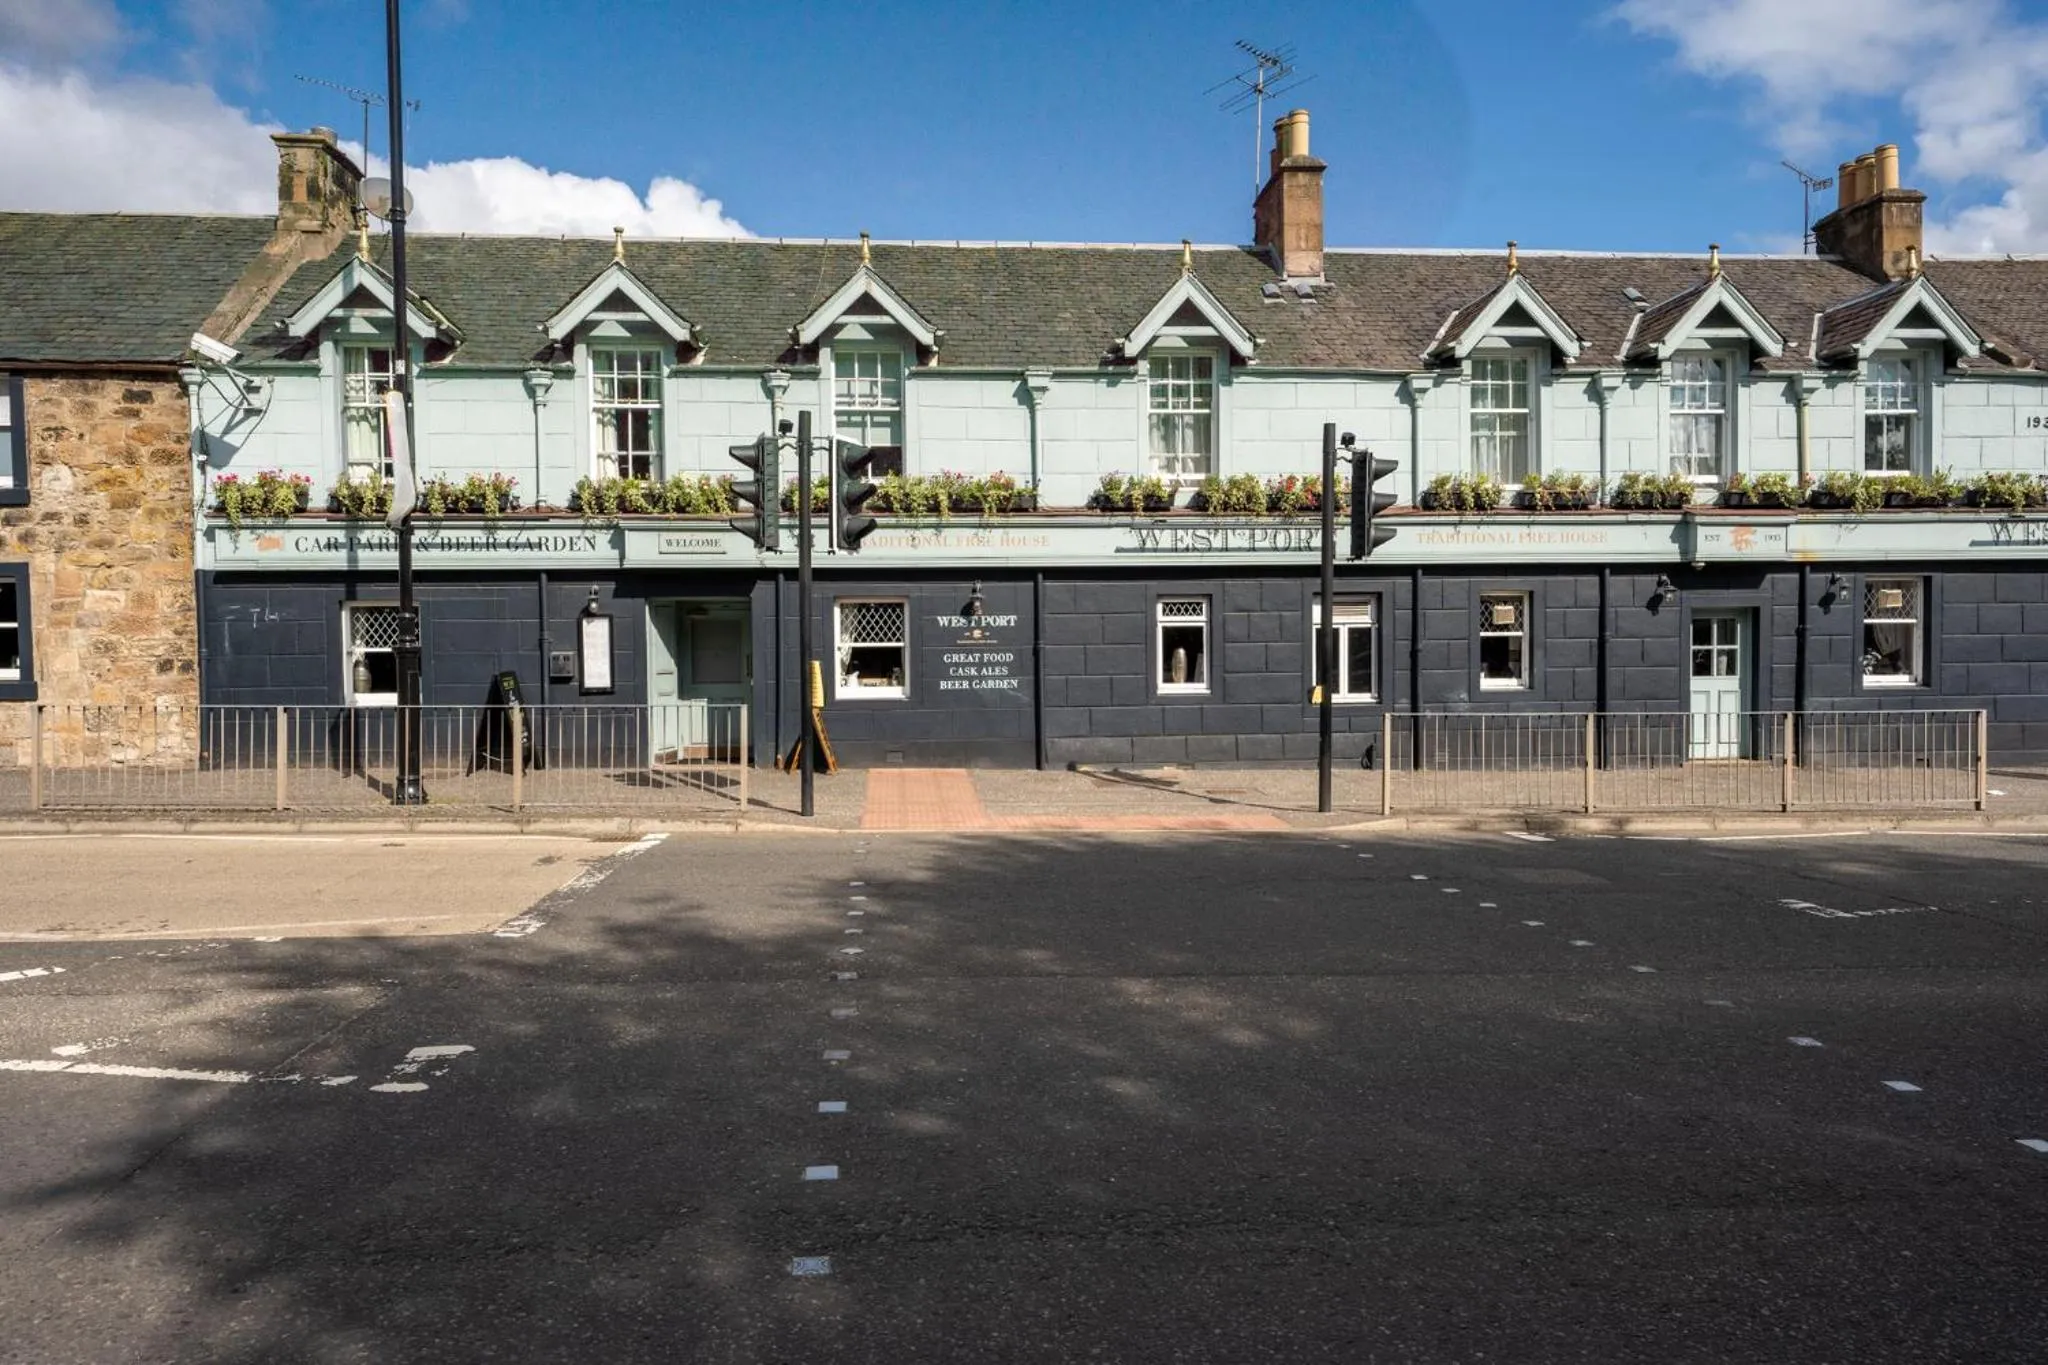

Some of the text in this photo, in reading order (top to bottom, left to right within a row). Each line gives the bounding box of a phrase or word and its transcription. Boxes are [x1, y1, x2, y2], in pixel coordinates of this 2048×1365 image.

[295, 537, 339, 552] CAR
[416, 536, 429, 552] &
[440, 536, 498, 551] BEER
[506, 536, 597, 551] GARDEN
[666, 539, 721, 547] WELCOME
[861, 535, 1050, 548] ADITIONAL FREE HOUSE
[1131, 528, 1322, 551] WEST POR
[1417, 532, 1608, 544] TRADITIONAL FREE HOUSE
[937, 615, 1017, 627] WEST PORT
[943, 653, 1014, 663] GREAT FOOD
[949, 666, 1009, 676] CASK ALES
[940, 679, 1018, 689] BEER GARDEN
